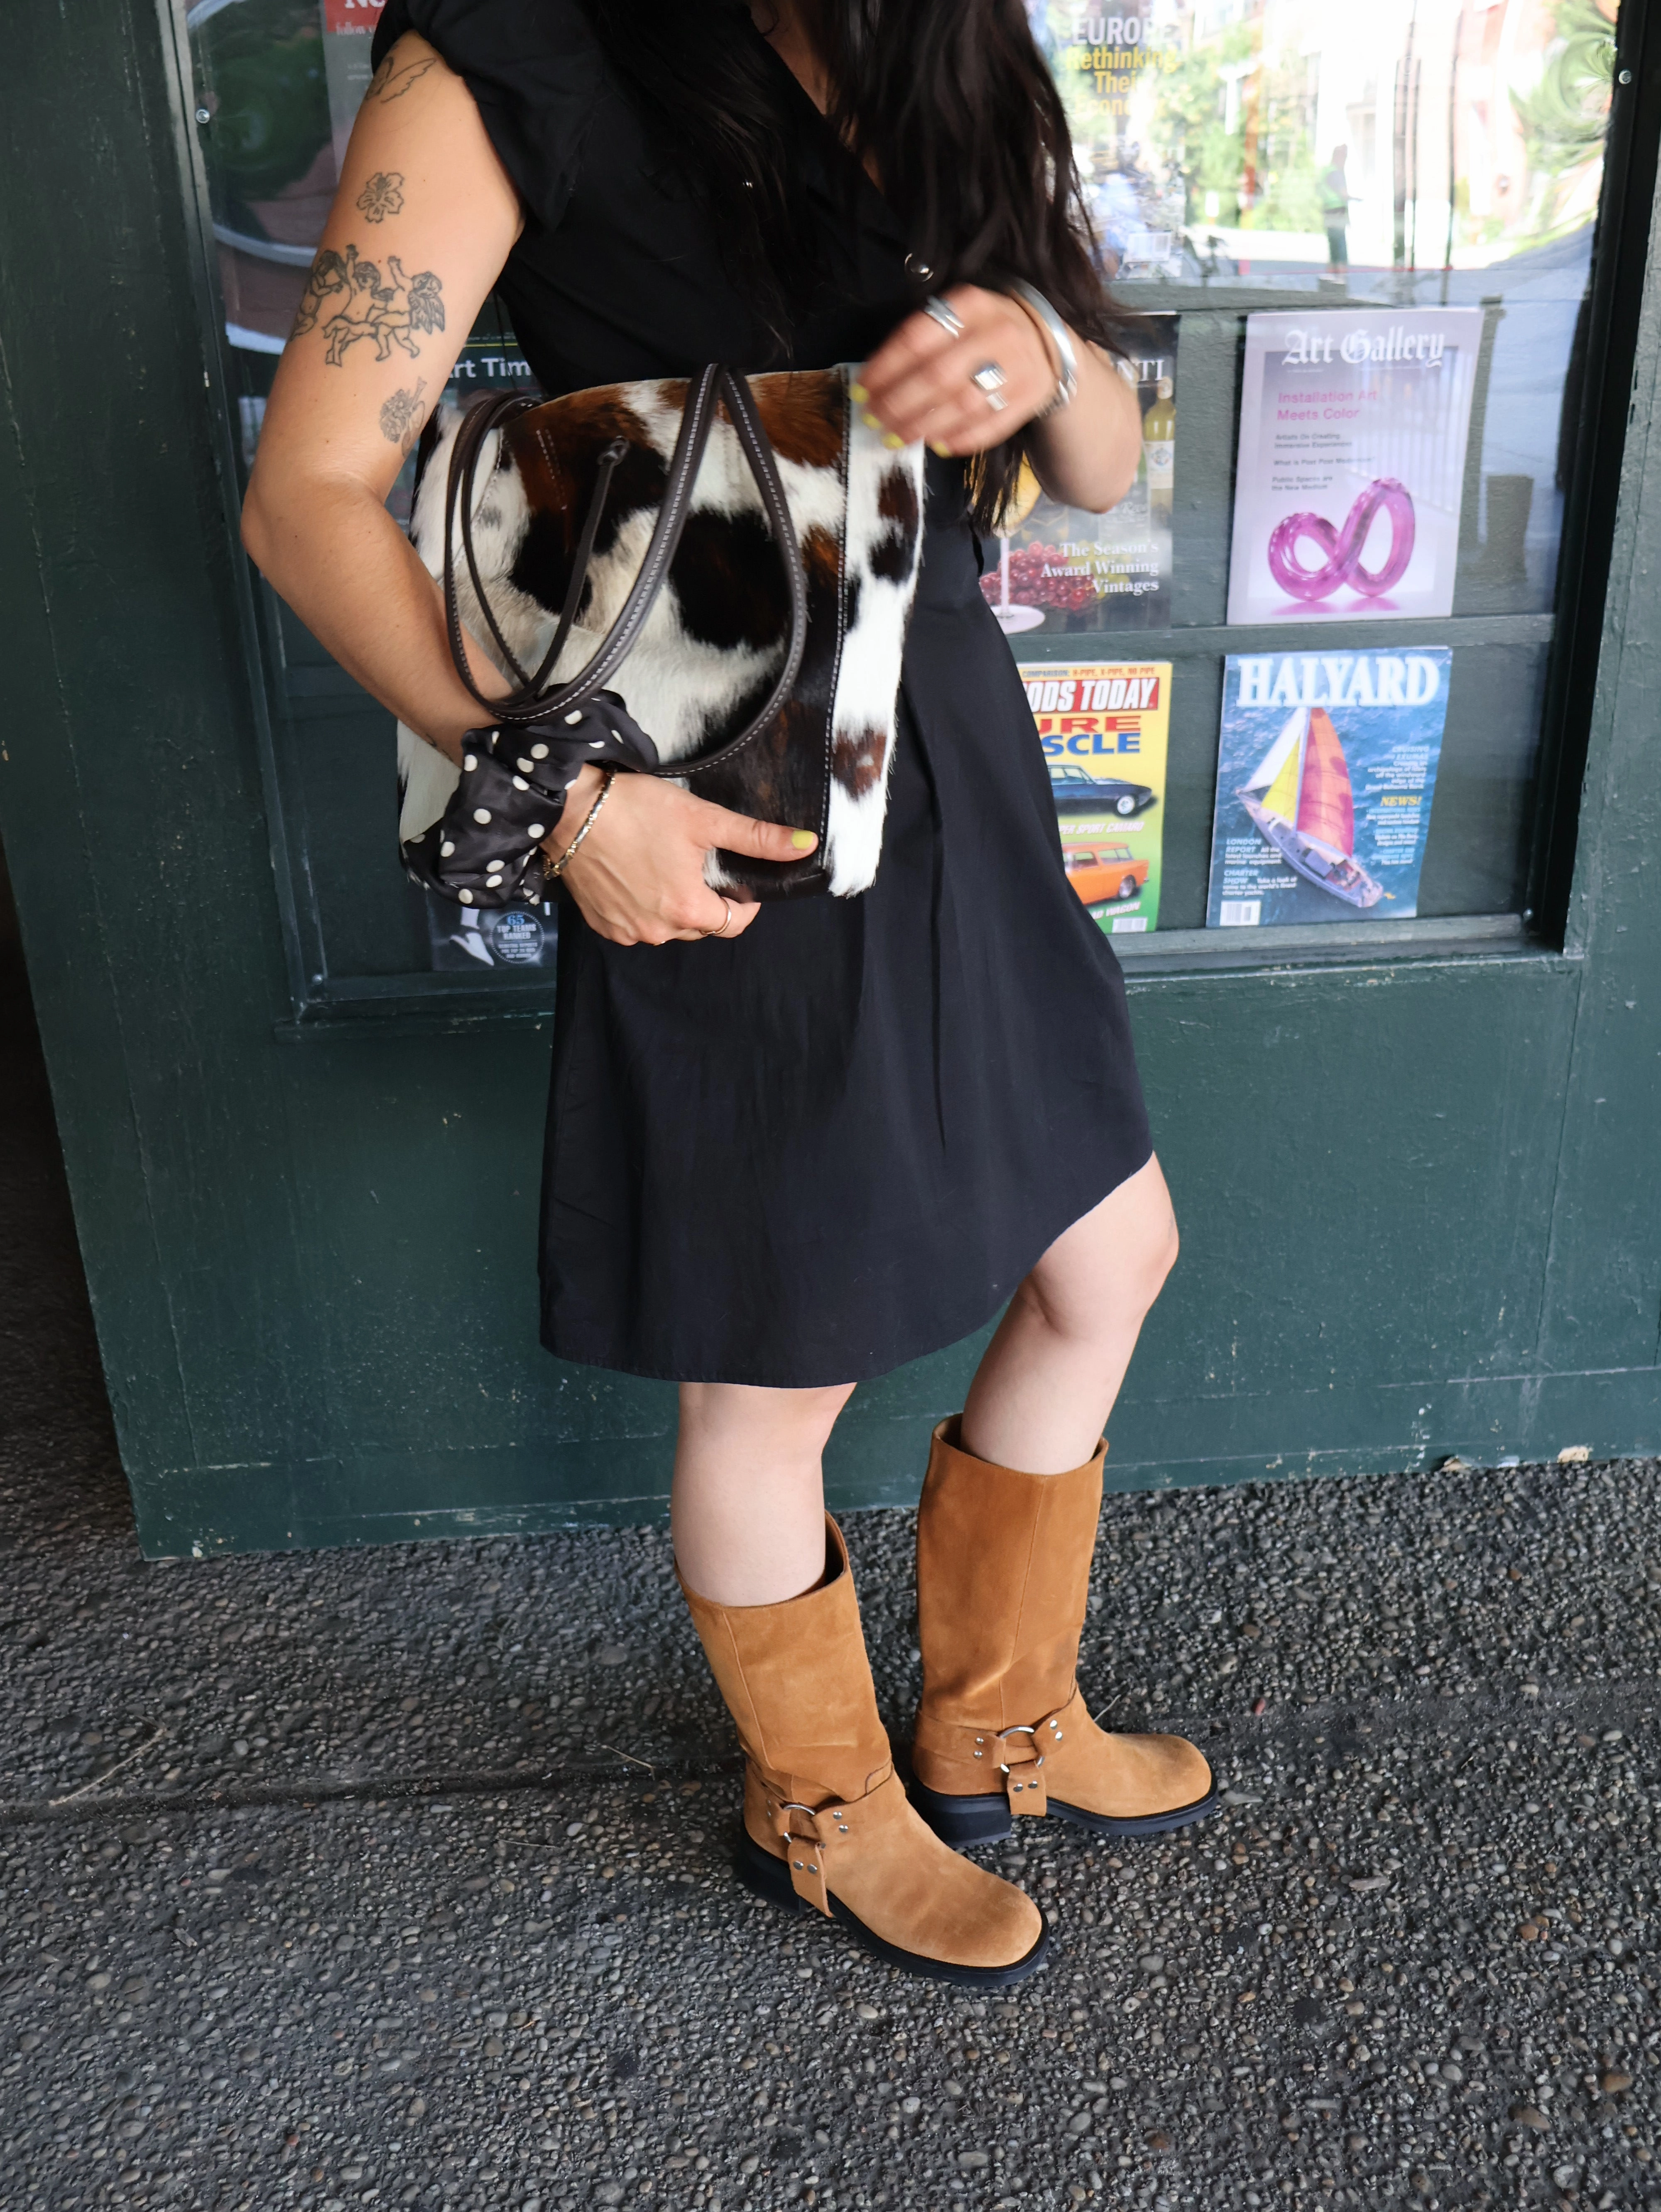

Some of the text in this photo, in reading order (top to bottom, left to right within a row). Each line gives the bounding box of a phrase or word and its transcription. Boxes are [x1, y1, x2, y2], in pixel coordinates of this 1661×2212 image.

[1066, 46, 1177, 74] Rethinking
[1094, 70, 1145, 94] Thei
[1281, 325, 1445, 368] Art Gallery
[1278, 390, 1377, 403] Installation Art
[1277, 408, 1360, 420] Meets Color
[1060, 541, 1159, 558] The Season's
[1041, 560, 1159, 578] Award Winning
[1092, 579, 1160, 596] Vintages
[1236, 656, 1441, 707] HALYARD
[1022, 677, 1157, 713] ODS TODAY
[1380, 796, 1422, 807] NEWS!
[1076, 823, 1106, 835] SPORT
[1105, 901, 1141, 917] WAGON
[507, 915, 525, 925] 65
[512, 924, 537, 932] TEAMS
[502, 932, 531, 940] RANKED
